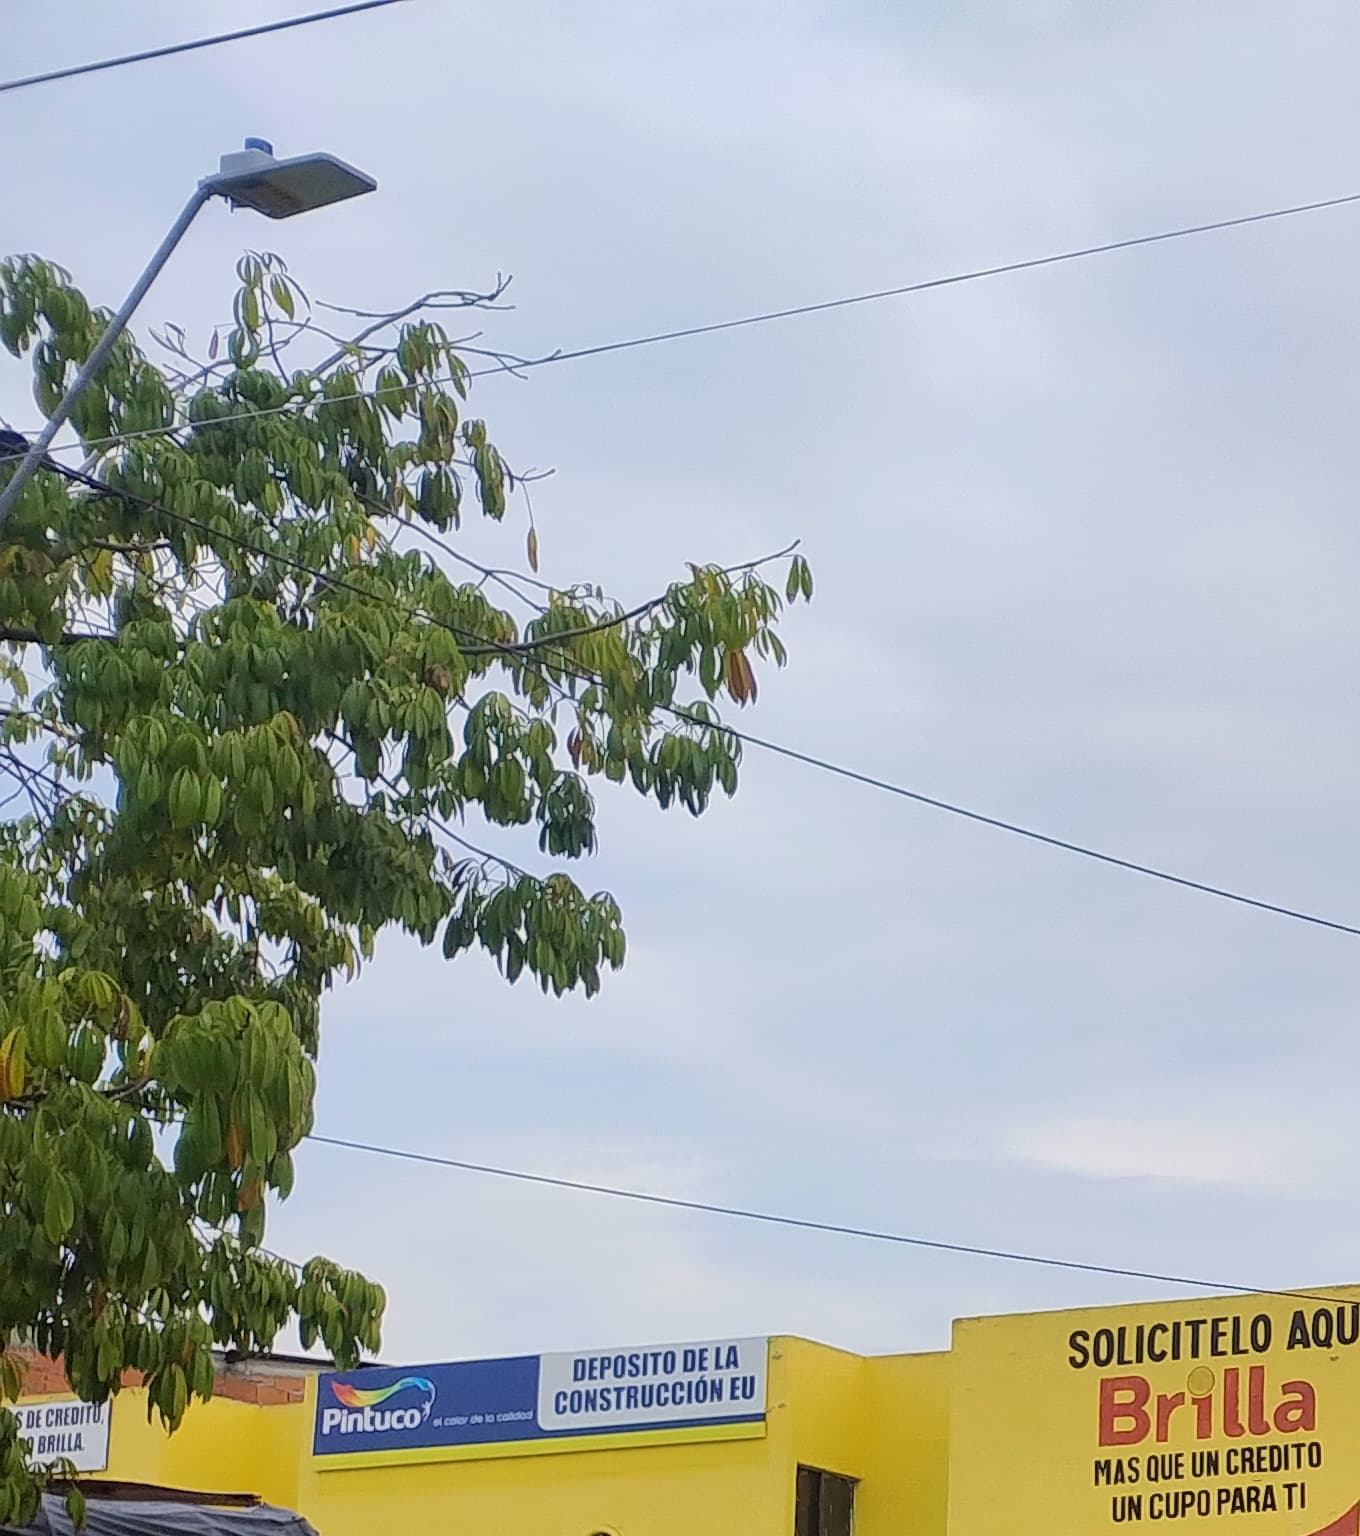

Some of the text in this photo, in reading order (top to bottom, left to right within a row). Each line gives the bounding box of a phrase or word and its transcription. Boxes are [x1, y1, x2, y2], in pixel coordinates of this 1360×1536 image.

[1068, 1313, 1272, 1369] SOLICITELO
[573, 1345, 739, 1382] DEPOSITO DE LA
[554, 1376, 755, 1415] CONSTRUCCIÓN EU
[1098, 1365, 1316, 1447] Brilla
[26, 1409, 42, 1429] DE
[321, 1406, 421, 1435] Pintuco
[1094, 1442, 1322, 1486] MAS QUE UN CREDITO
[1112, 1482, 1306, 1523] UN CUPO PARA TI
